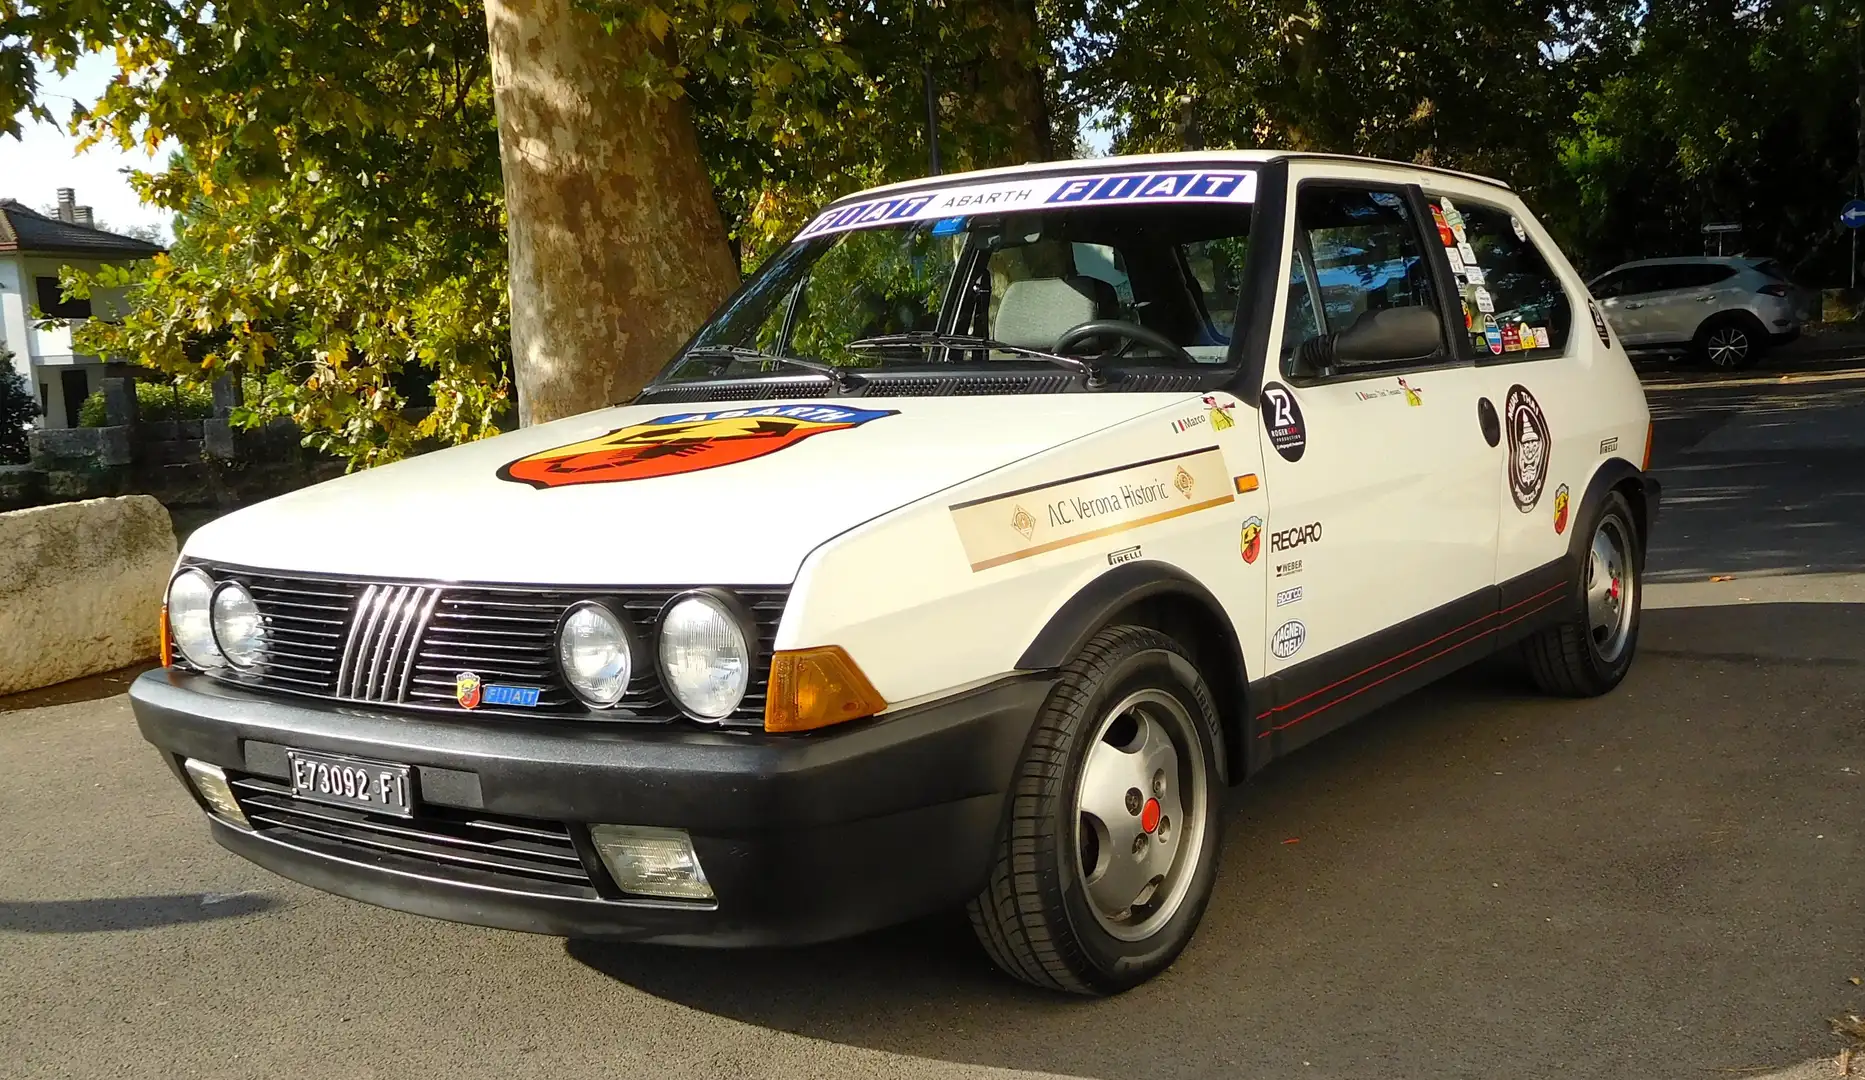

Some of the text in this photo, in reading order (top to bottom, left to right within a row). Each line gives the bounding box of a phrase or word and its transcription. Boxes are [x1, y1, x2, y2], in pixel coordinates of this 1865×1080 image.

[807, 175, 1240, 233] FIAT ABARTH FIAT
[1520, 391, 1539, 416] THAI
[672, 406, 856, 424] ABARTH
[1183, 414, 1206, 429] Marco
[1047, 478, 1169, 527] A.C. Verona Historic
[1271, 522, 1322, 553] RECARO
[1108, 545, 1142, 565] PIRELLI
[1282, 559, 1303, 573] WEBER
[1277, 587, 1302, 604] sparco
[487, 688, 536, 704] FIAT
[294, 759, 404, 807] E73092 FI
